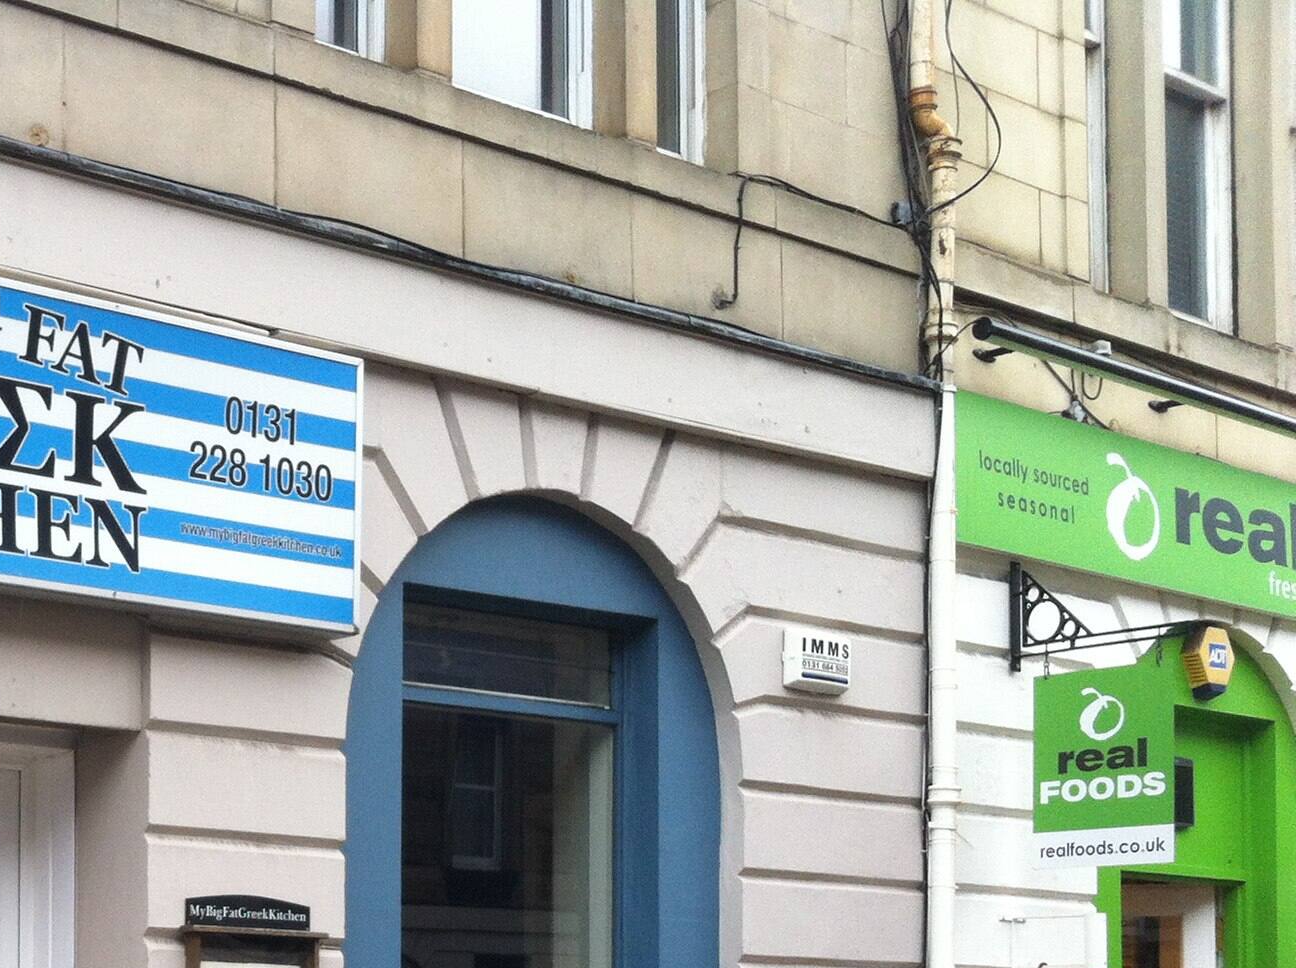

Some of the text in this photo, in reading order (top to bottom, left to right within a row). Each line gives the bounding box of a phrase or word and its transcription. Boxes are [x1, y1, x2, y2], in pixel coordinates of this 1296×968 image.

[19, 304, 144, 396] FAT
[225, 396, 296, 445] 0131
[189, 441, 332, 501] 228 1030
[979, 449, 1089, 496] locally sourced
[997, 492, 1075, 524] seasonal
[802, 637, 849, 659] IMMS
[1057, 737, 1148, 775] real
[1039, 771, 1166, 804] FOODS
[1040, 837, 1166, 859] realfoods.co.uk
[189, 904, 307, 922] MyBigFatGreekKitchen
